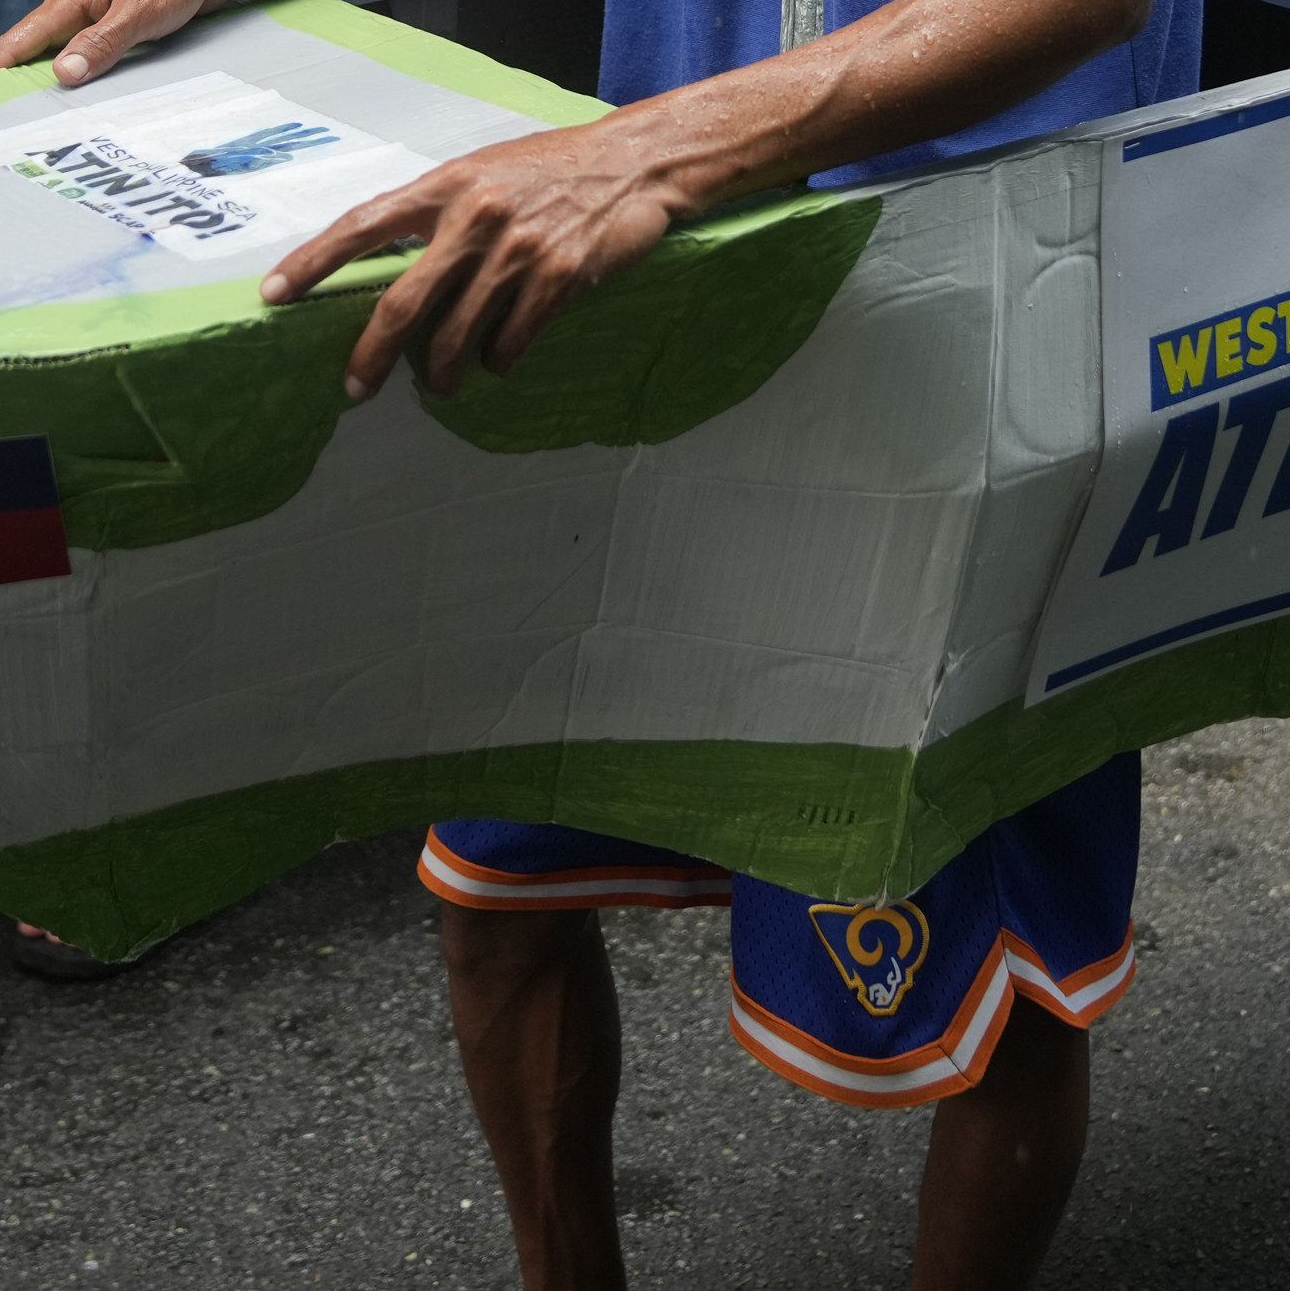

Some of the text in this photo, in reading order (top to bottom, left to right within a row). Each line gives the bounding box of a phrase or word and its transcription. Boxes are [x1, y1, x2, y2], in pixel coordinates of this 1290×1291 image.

[23, 142, 245, 240] ATIN ITO!
[108, 213, 146, 229] SCAP
[217, 200, 258, 222] SEA
